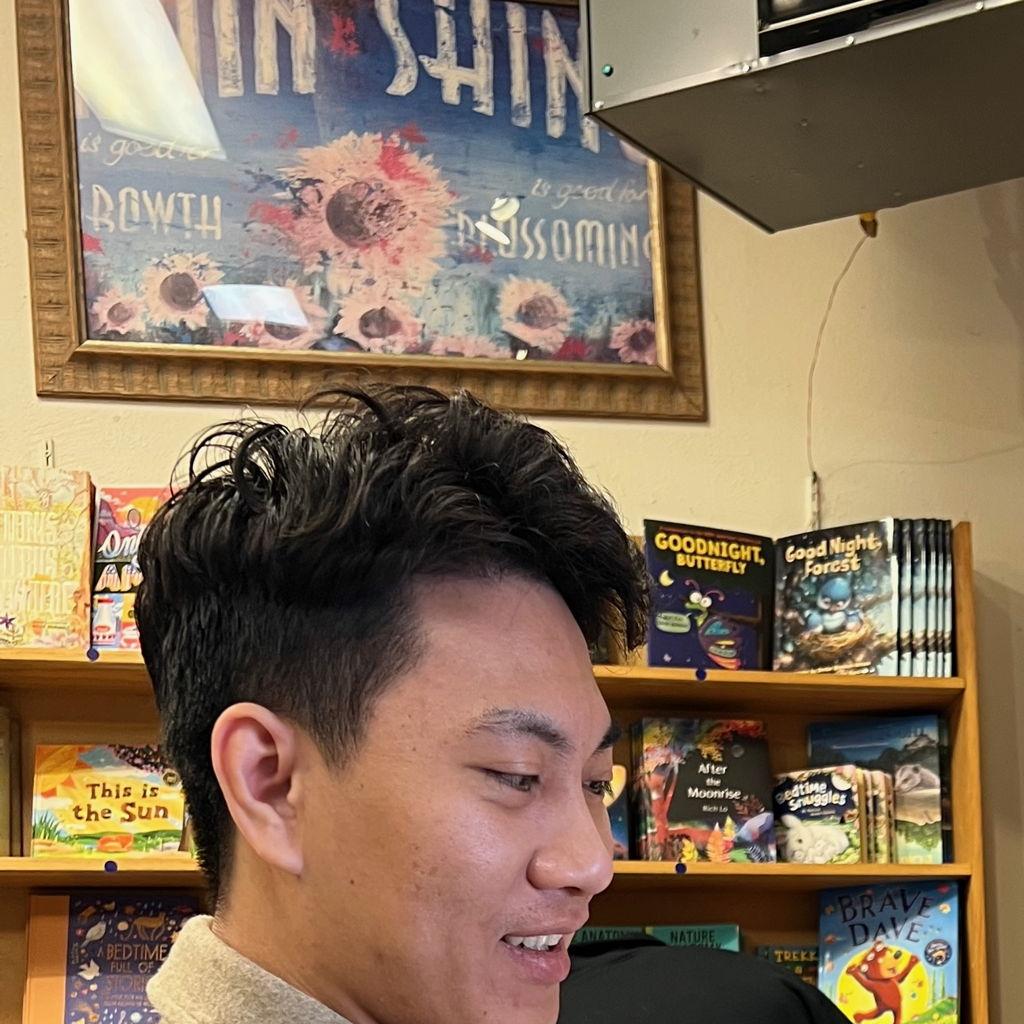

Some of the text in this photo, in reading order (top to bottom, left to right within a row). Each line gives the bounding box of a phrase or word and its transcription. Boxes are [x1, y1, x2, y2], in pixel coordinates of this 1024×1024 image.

[376, 0, 600, 154] SHIN
[85, 184, 222, 240] ROWTH
[655, 532, 766, 566] GOODNIGHT,
[785, 540, 827, 563] Good
[676, 553, 748, 575] BUTTERFLY
[805, 555, 862, 576] Forest
[698, 763, 727, 775] After
[86, 782, 160, 799] This is
[706, 777, 721, 787] the
[687, 787, 742, 800] Moonrise
[788, 792, 847, 811] Snuggles
[72, 802, 169, 822] the Sun
[702, 804, 717, 813] Rich
[837, 889, 932, 923] BRAVE
[670, 930, 717, 944] NATURE
[848, 917, 923, 947] DAVE
[106, 943, 168, 961] BEDTIME
[774, 950, 818, 962] TREKK
[110, 961, 155, 973] FULL OF
[105, 974, 148, 992] STORI
